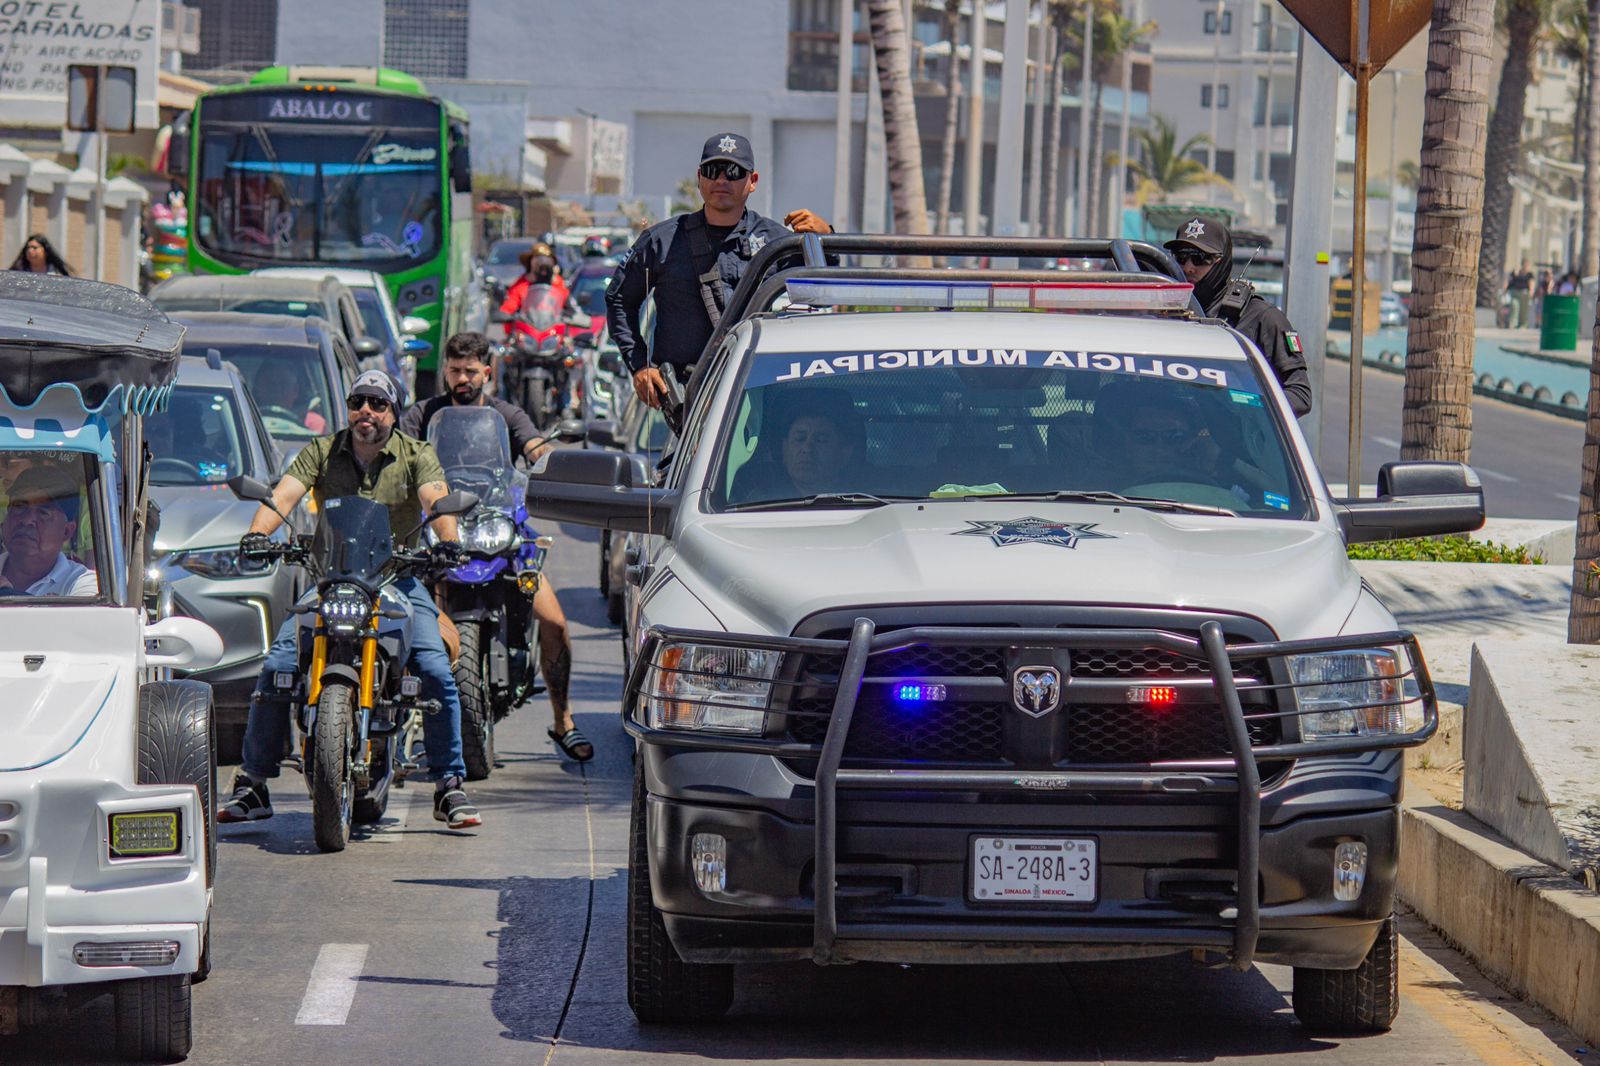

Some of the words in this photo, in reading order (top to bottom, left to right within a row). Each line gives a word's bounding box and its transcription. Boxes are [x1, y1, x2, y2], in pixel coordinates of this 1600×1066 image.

[1, 1, 85, 20] OTEL
[0, 77, 28, 91] NG
[269, 98, 351, 120] ABALO
[980, 855, 1091, 882] SA-248A-3
